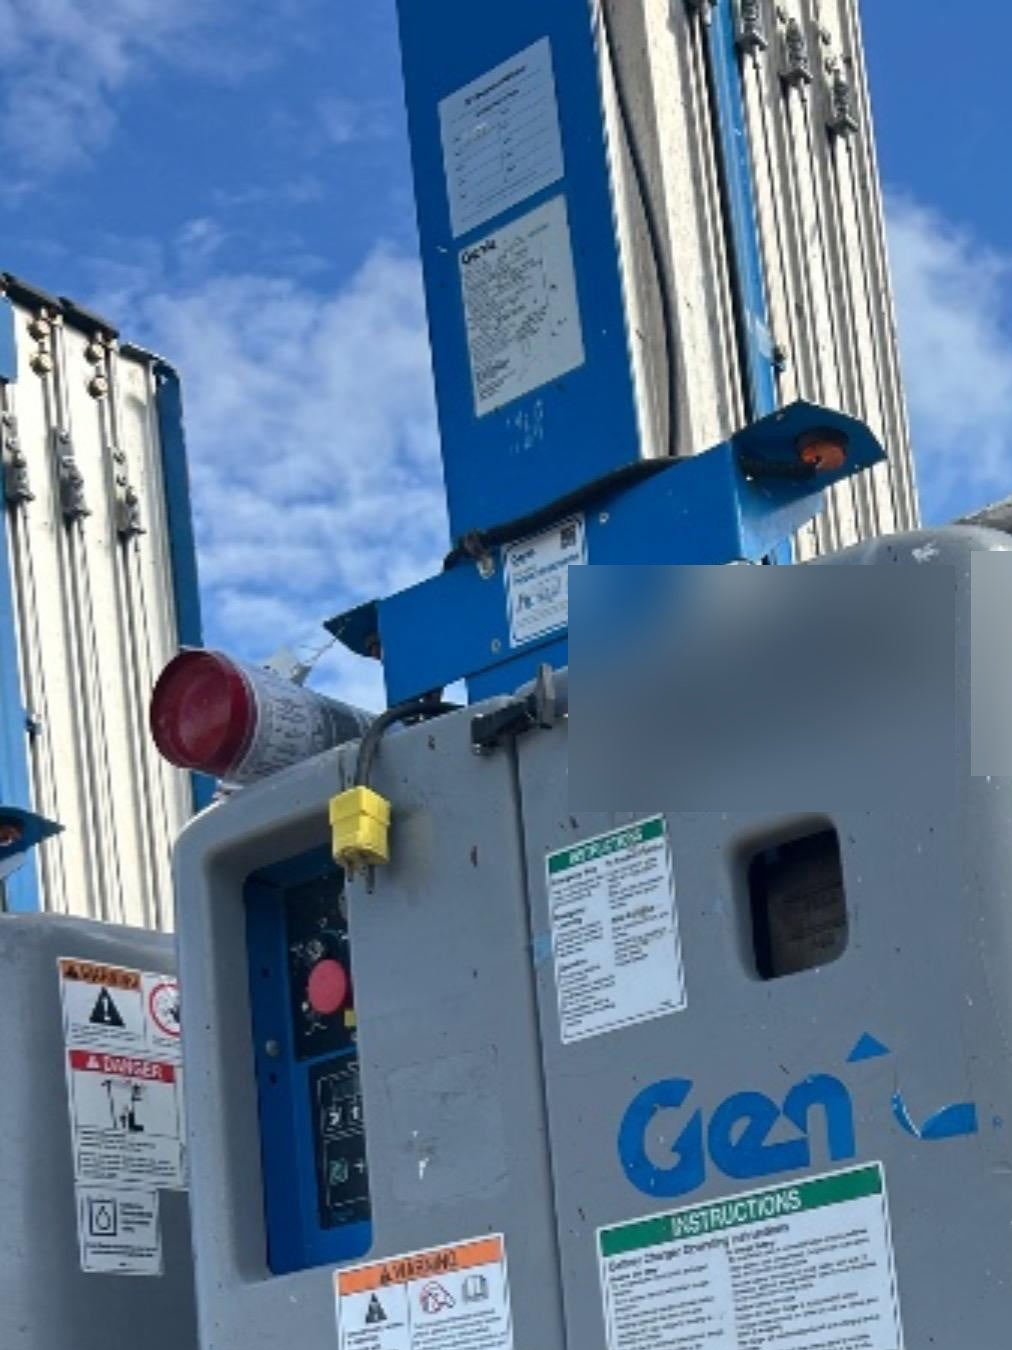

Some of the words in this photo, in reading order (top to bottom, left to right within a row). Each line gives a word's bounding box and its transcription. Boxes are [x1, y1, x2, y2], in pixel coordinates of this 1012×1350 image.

[103, 1055, 162, 1079] DANGER
[617, 1031, 979, 1198] Gen
[671, 1190, 802, 1237] INSTRUCTIONS
